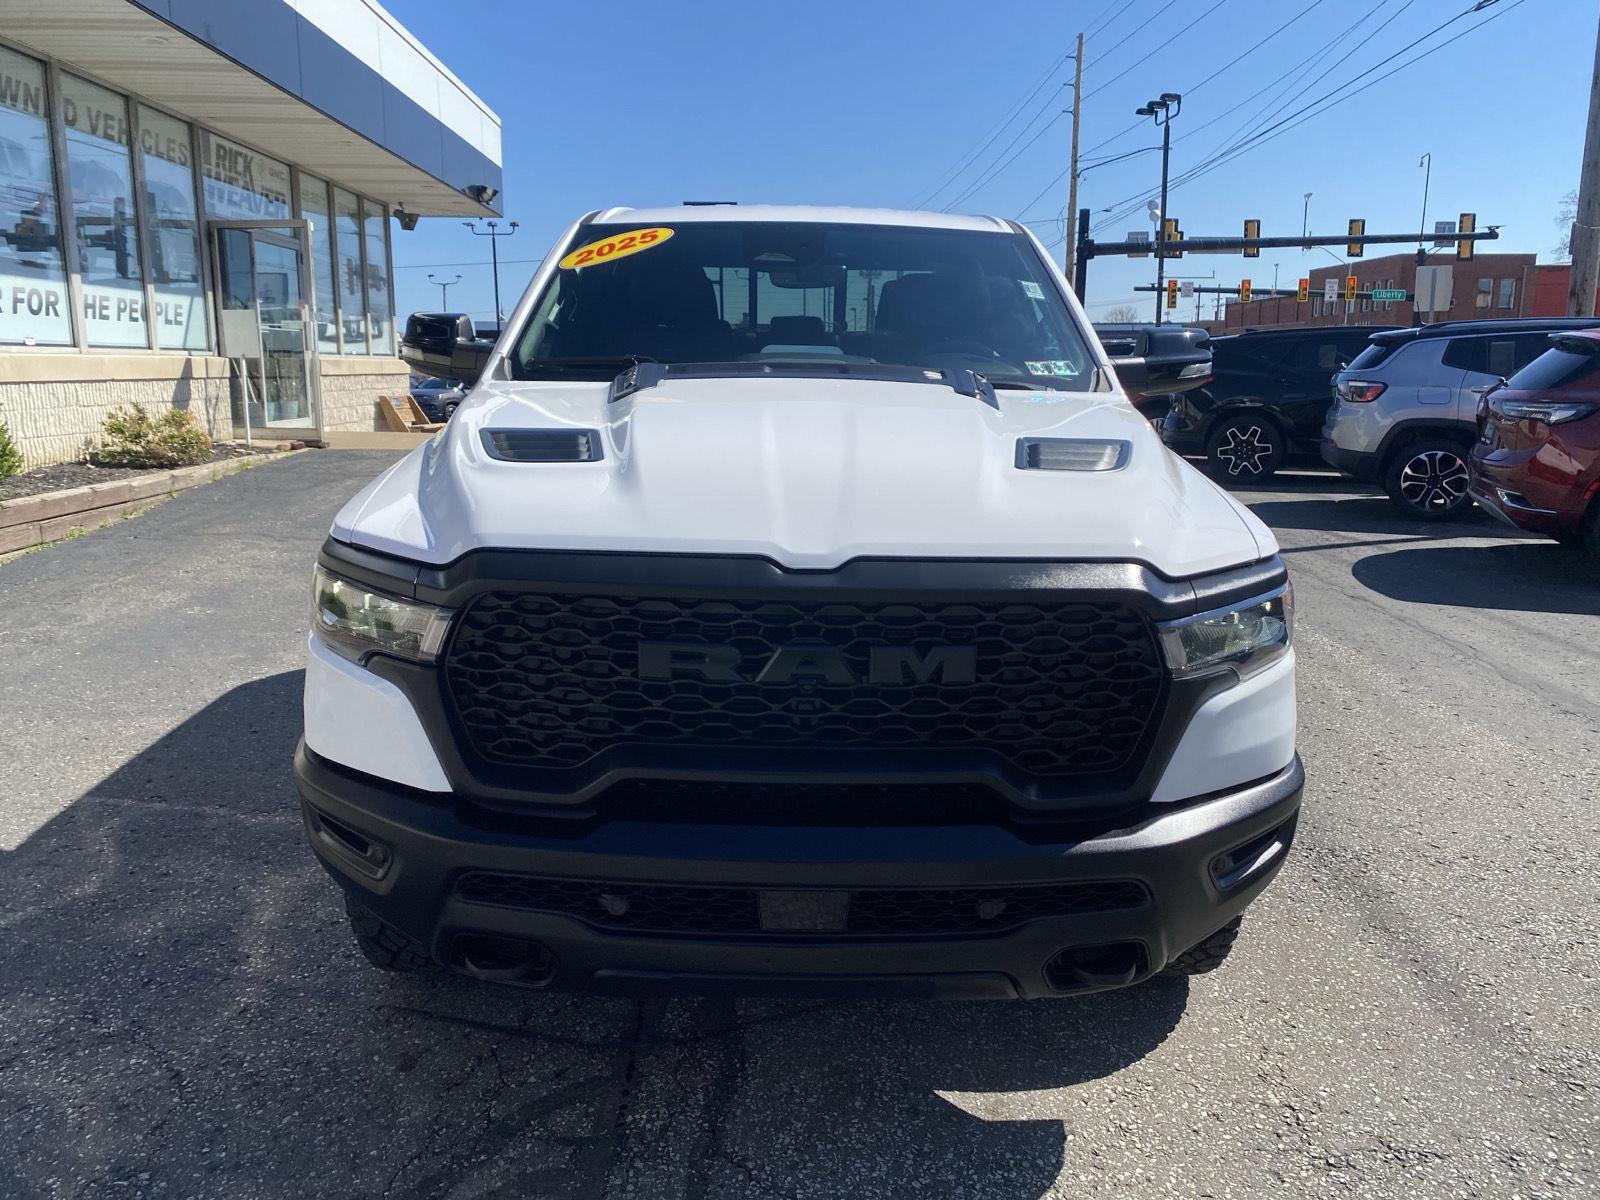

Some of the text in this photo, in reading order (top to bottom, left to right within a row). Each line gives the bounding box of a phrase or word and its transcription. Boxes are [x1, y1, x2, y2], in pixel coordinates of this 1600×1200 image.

[87, 106, 188, 166] VEHCLES
[215, 142, 254, 178] RICK
[573, 230, 659, 266] 2025
[12, 286, 59, 317] FOR
[85, 293, 110, 320] HE
[1376, 291, 1402, 299] Liberty
[638, 640, 977, 684] RAM
